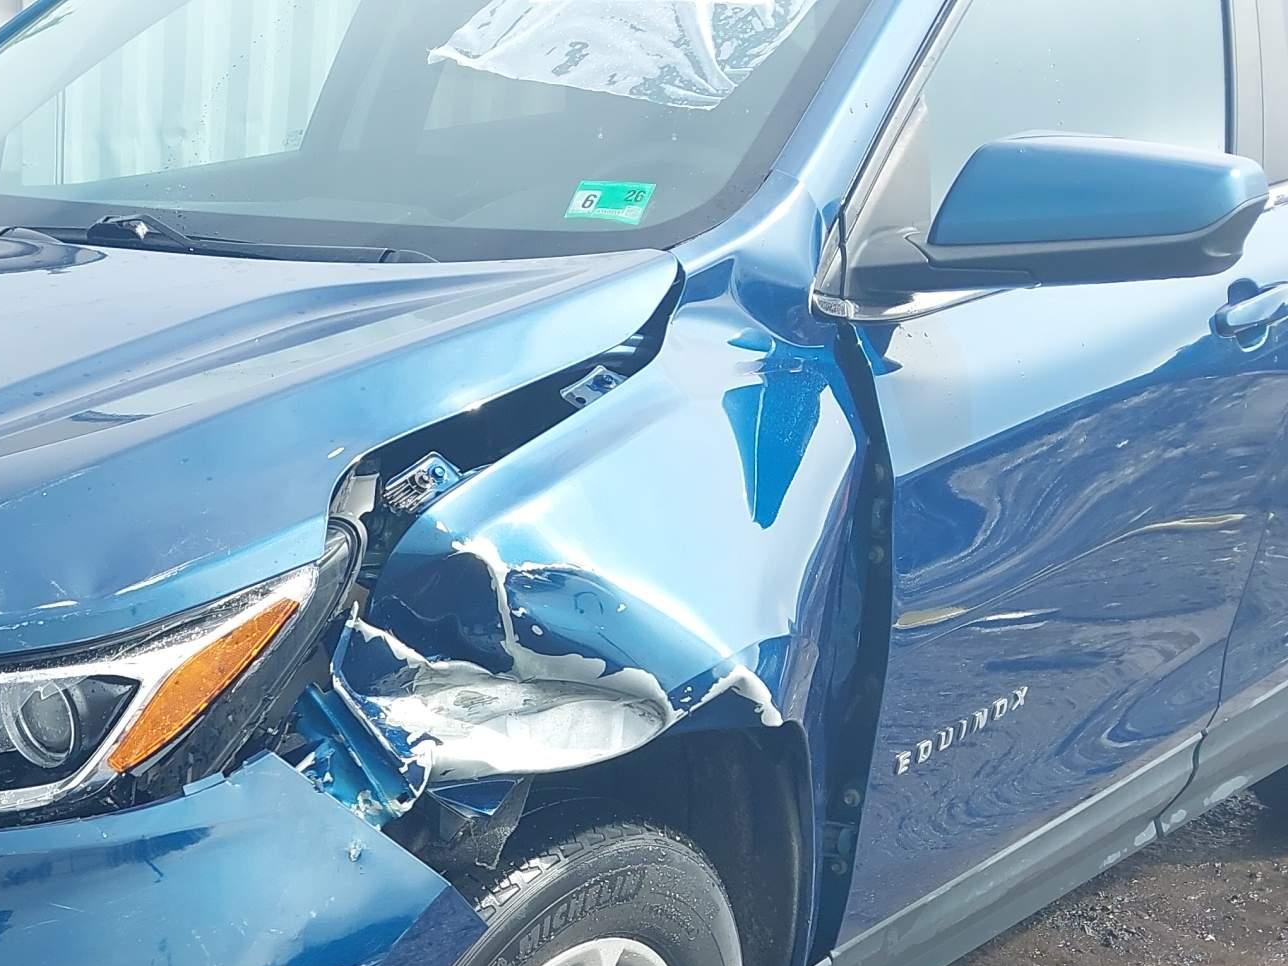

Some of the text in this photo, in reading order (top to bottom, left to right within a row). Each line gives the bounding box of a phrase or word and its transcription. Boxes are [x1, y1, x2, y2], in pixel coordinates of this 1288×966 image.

[581, 193, 598, 209] 6
[623, 189, 647, 203] 26
[895, 686, 1028, 776] EQUINOX
